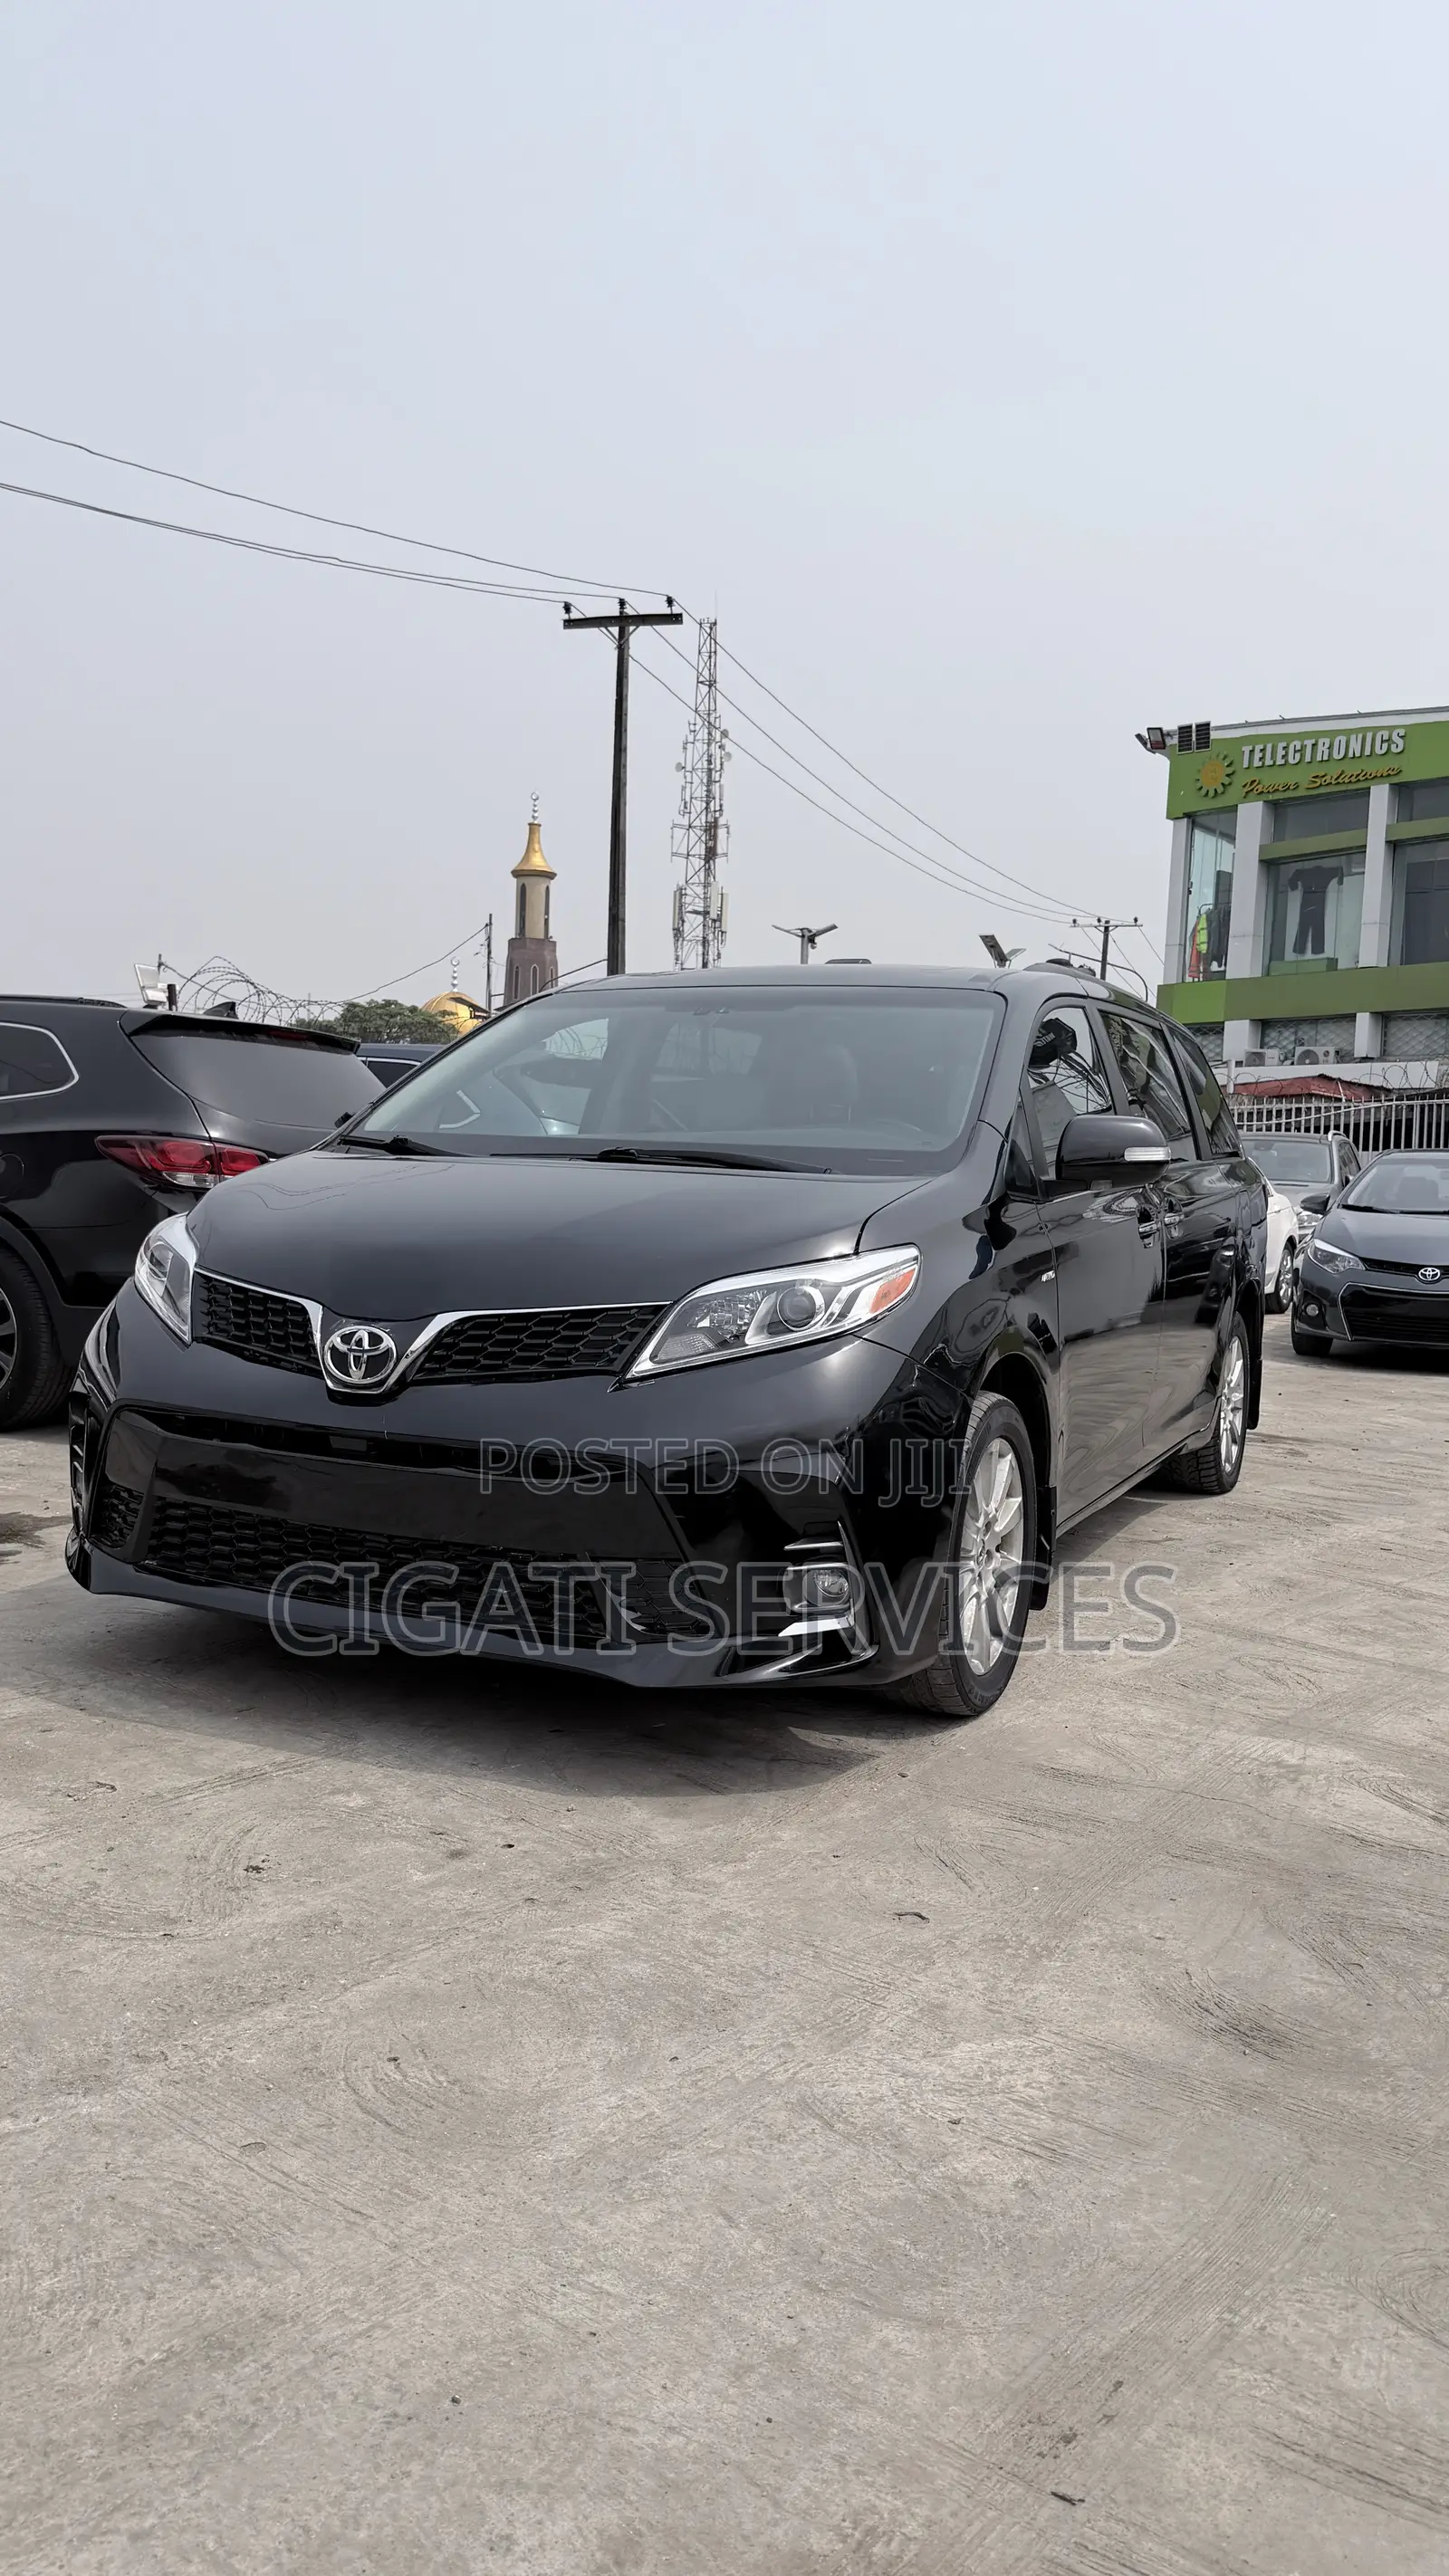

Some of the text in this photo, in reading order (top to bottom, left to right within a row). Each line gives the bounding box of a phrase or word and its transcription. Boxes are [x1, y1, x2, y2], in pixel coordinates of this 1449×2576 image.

[1242, 728, 1406, 769] TELECTRONICS
[1242, 765, 1402, 799] Power Solutions
